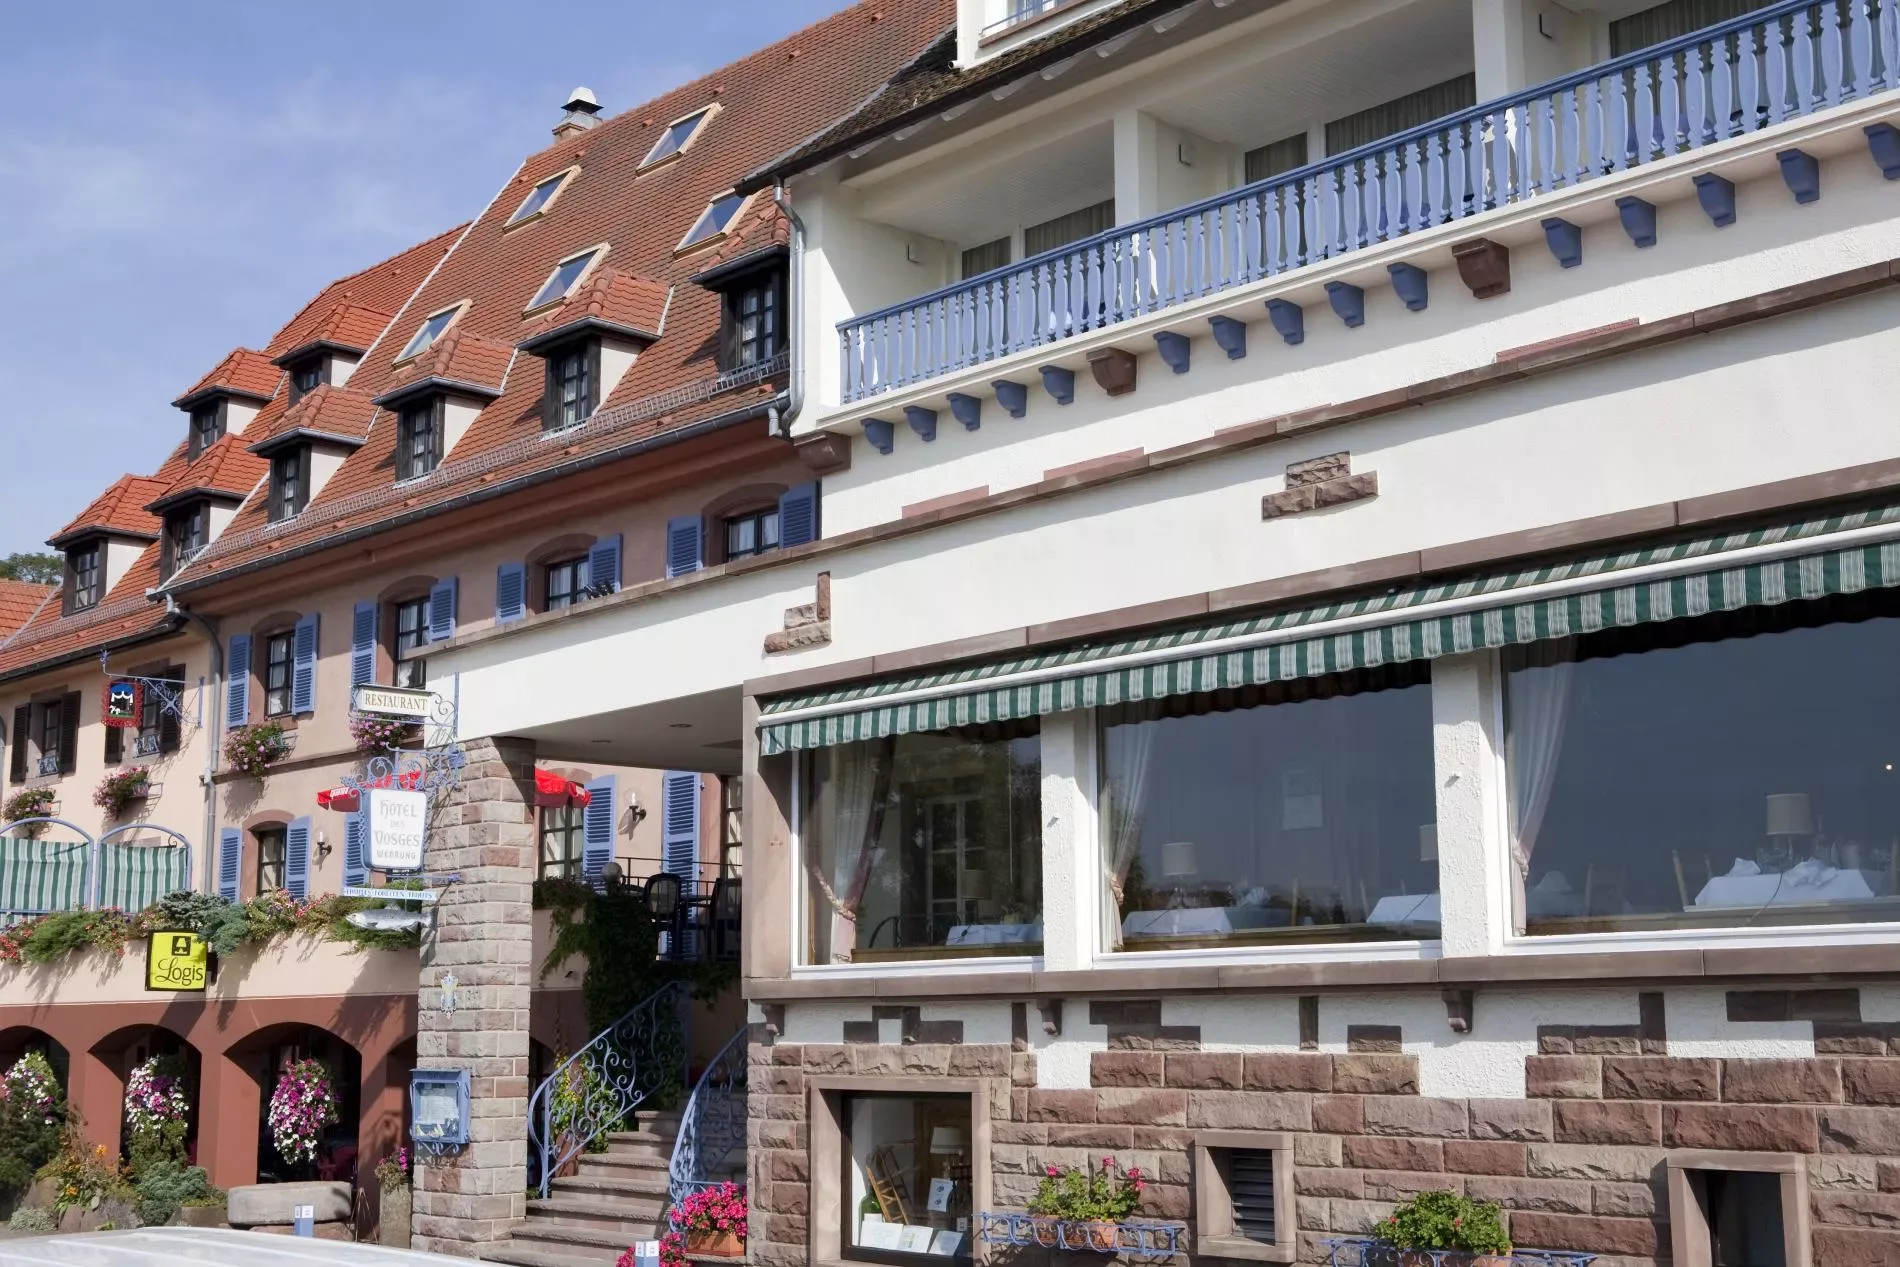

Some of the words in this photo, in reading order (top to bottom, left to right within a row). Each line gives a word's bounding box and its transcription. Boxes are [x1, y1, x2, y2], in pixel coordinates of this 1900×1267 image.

[365, 693, 428, 711] RESTAURANT
[374, 830, 421, 847] VOSGES
[155, 957, 204, 987] Logis
